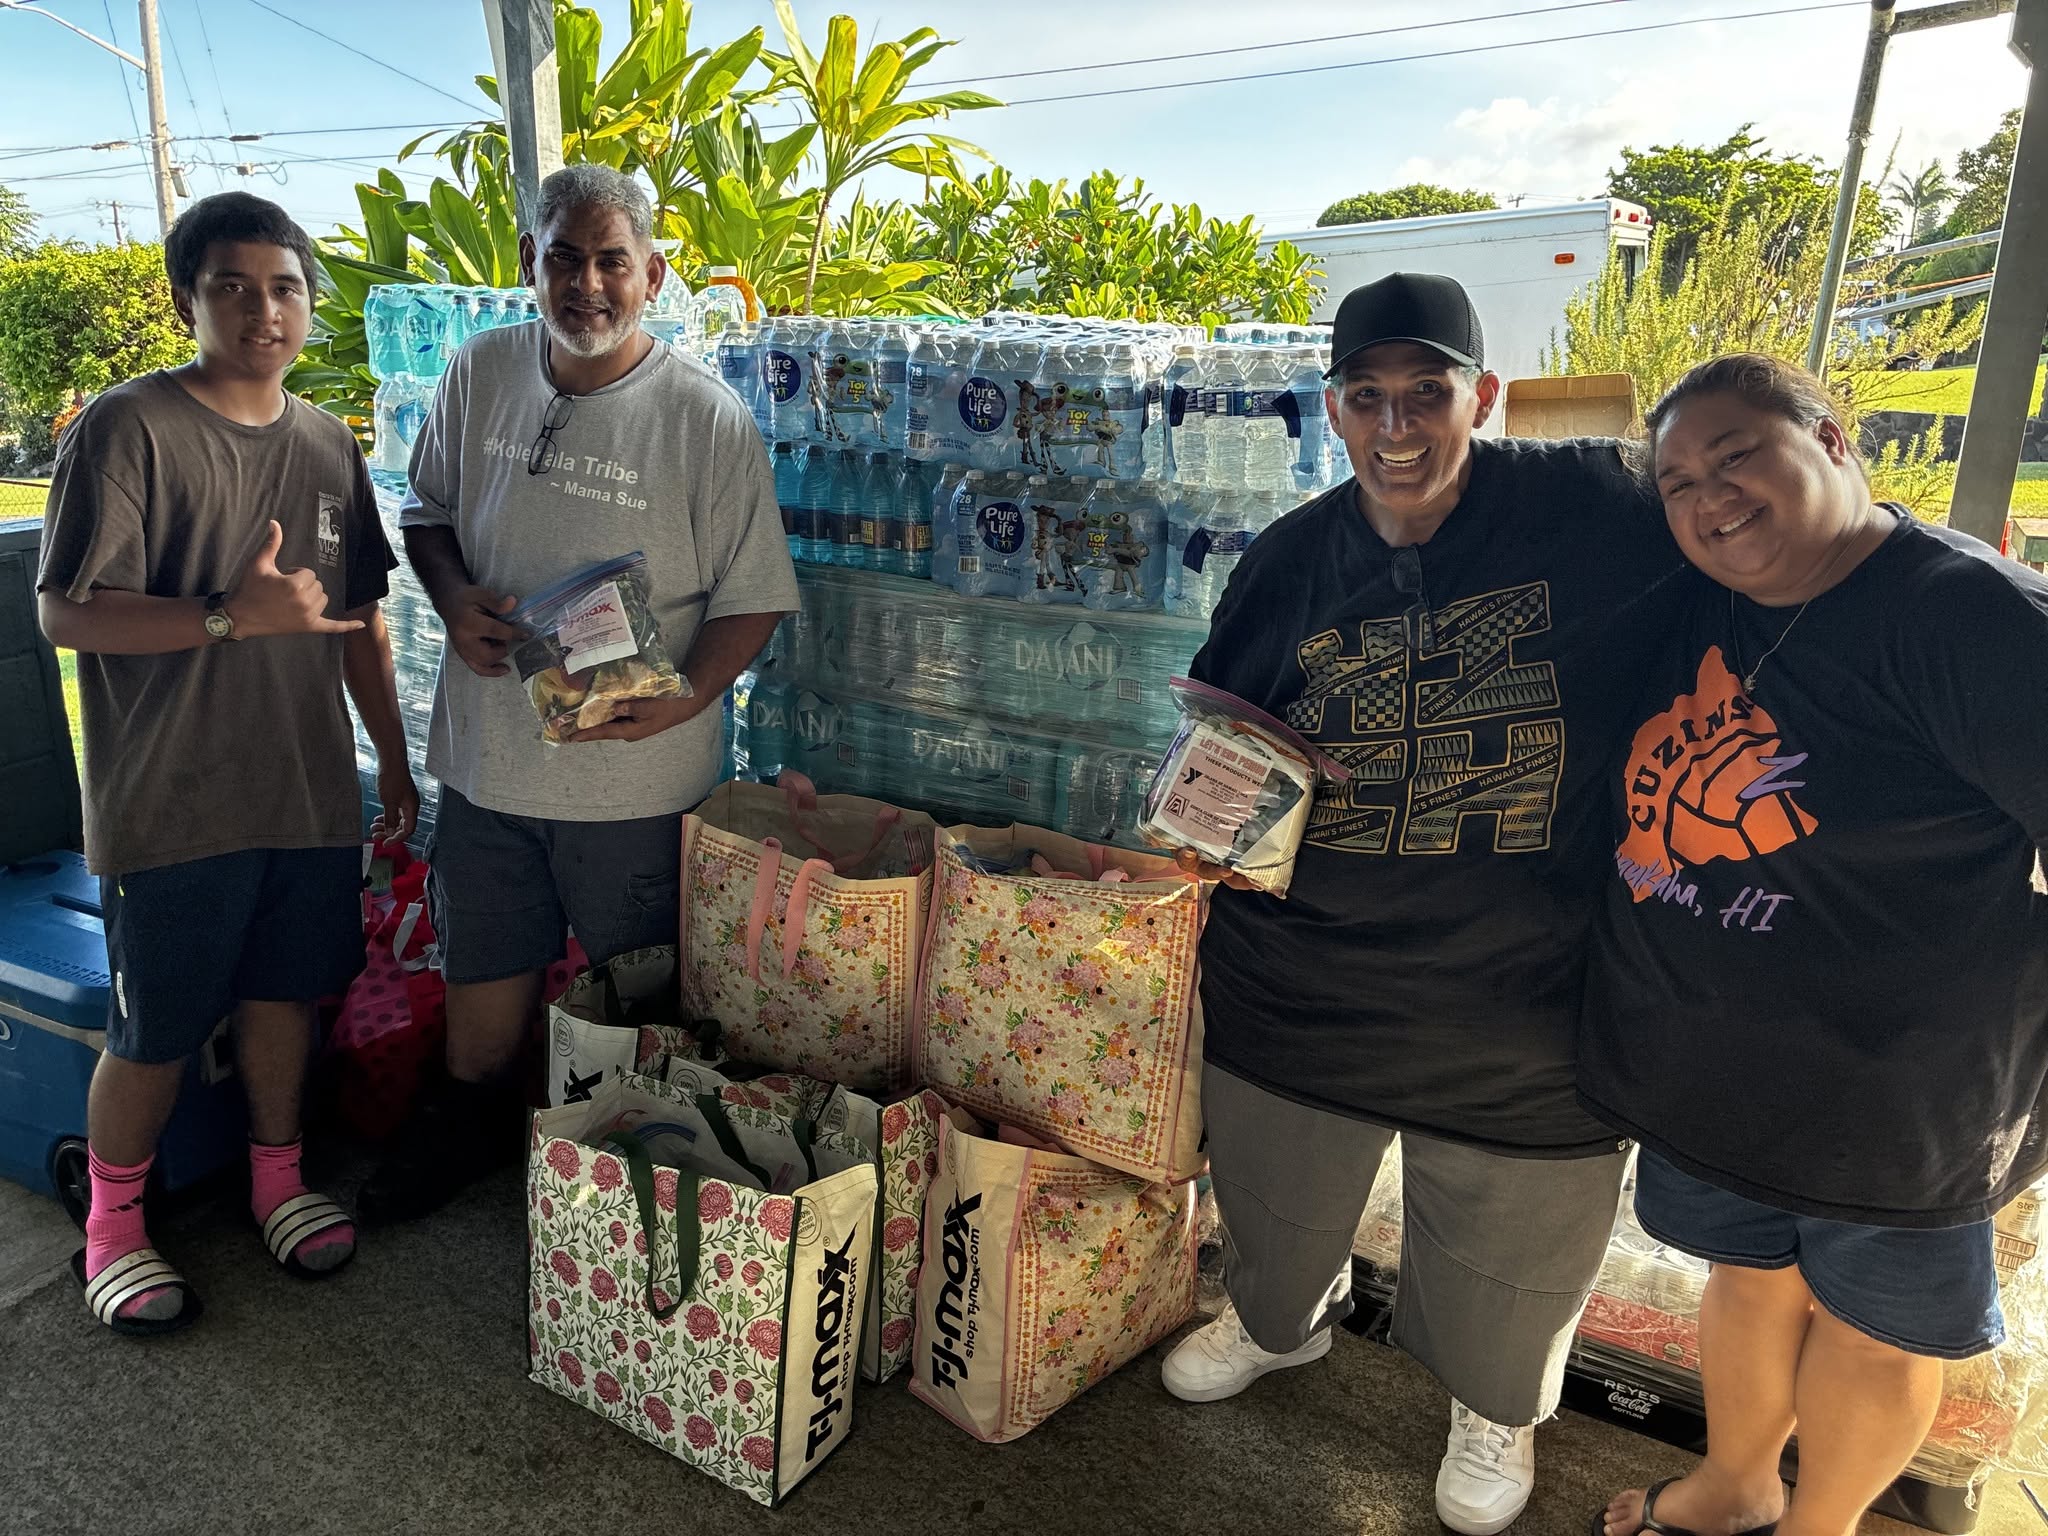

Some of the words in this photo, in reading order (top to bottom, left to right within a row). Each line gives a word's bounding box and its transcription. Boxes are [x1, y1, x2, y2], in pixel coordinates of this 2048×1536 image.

[966, 383, 997, 400] Pure
[968, 397, 992, 416] Life
[584, 456, 639, 485] Tribe
[564, 481, 611, 502] Mama
[615, 491, 648, 510] Sue
[959, 495, 972, 504] 28
[985, 507, 1019, 522] Pure
[990, 520, 1015, 538] Life
[1428, 688, 1458, 714] FINEST
[1205, 756, 1222, 768] THESE
[1222, 764, 1251, 782] PRODUCTS
[1632, 695, 1754, 832] CUZINS
[1428, 788, 1463, 807] FINEST
[1478, 763, 1524, 788] HAWAII'S
[1525, 749, 1558, 770] FINEST
[1338, 819, 1369, 834] FINEST
[1719, 886, 1794, 932] HI
[963, 1319, 979, 1360] shop
[841, 1350, 851, 1392] shop
[1604, 1379, 1660, 1404] REYES
